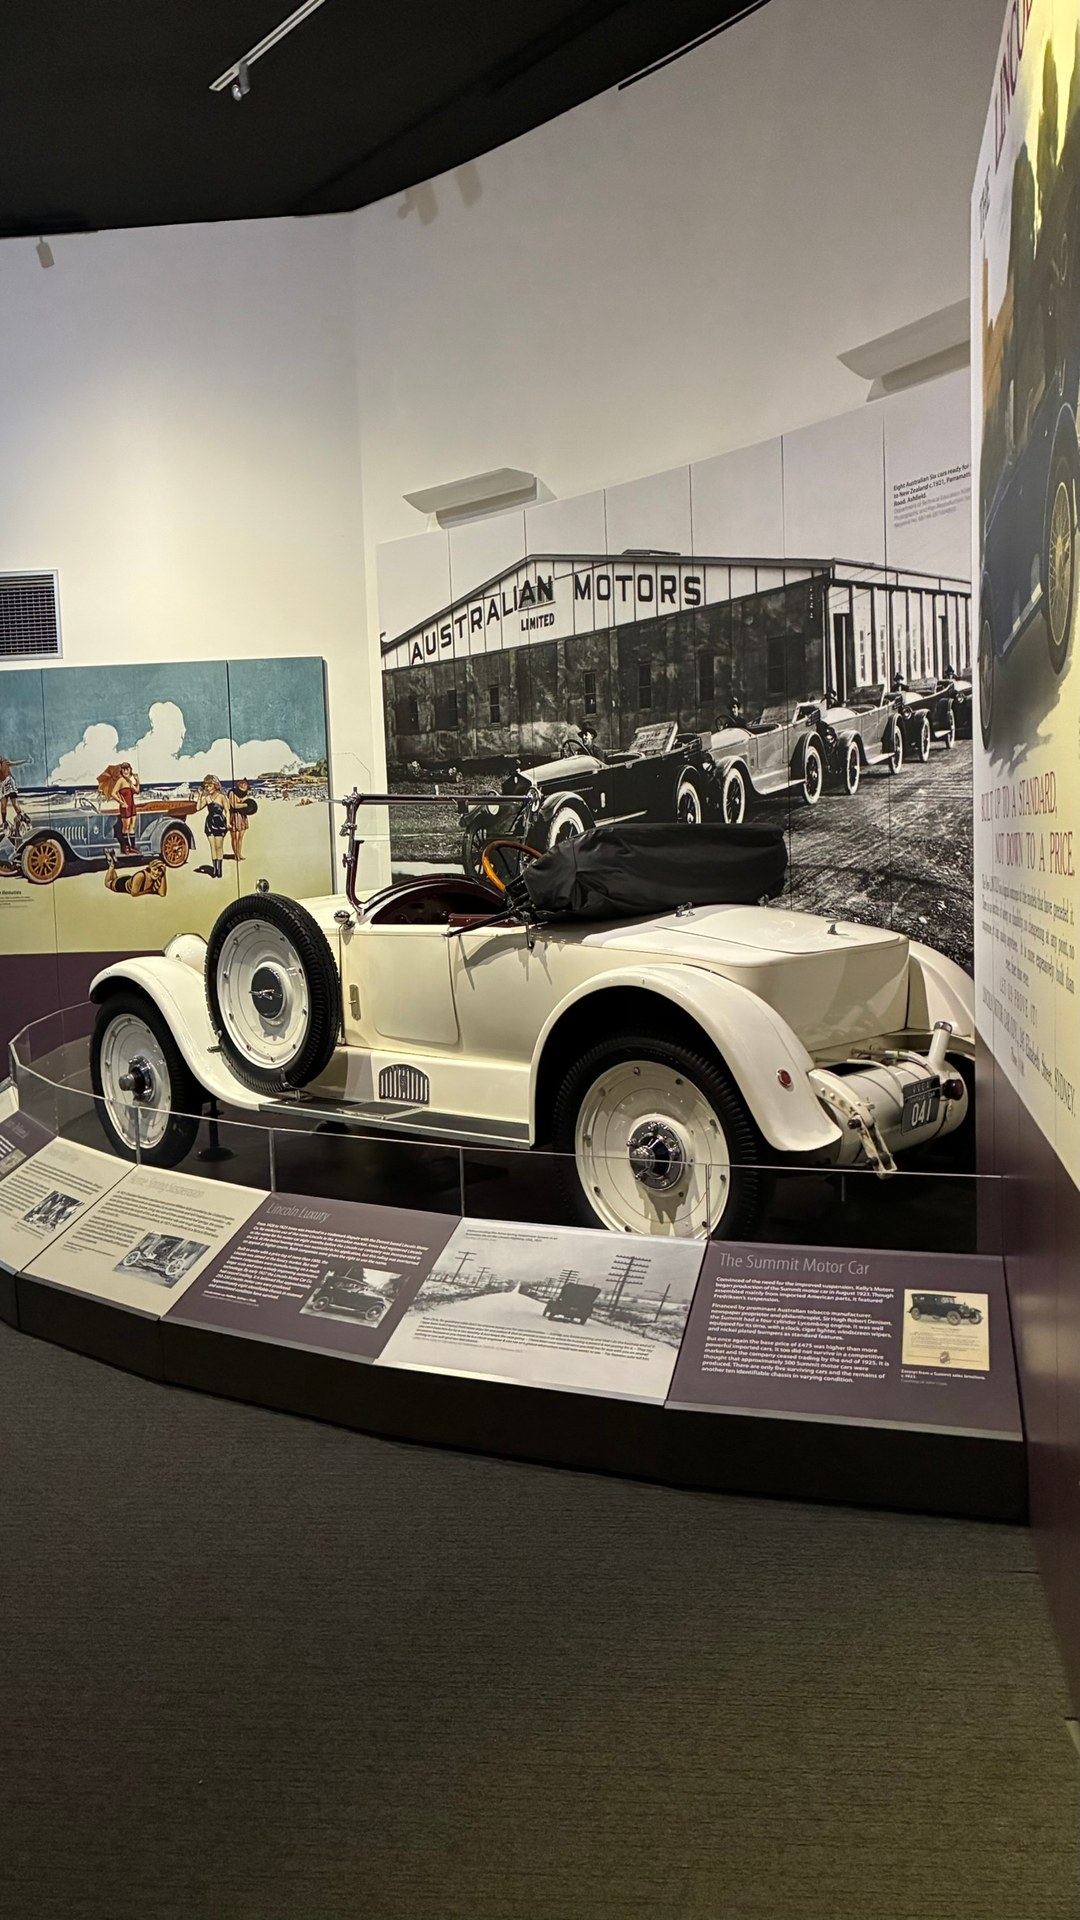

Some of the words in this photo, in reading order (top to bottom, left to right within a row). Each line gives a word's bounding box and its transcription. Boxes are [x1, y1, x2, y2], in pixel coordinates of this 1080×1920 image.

[906, 476, 929, 487] Australian
[948, 466, 961, 474] ready
[910, 484, 928, 494] Zealand
[575, 574, 701, 605] MOTORS
[412, 576, 552, 664] AUSTRALIAN
[521, 612, 555, 631] LIMITED
[994, 787, 1000, 818] UP
[1002, 785, 1009, 818] TO
[1011, 784, 1016, 818] A
[1018, 770, 1058, 818] STANDARD,
[1006, 831, 1023, 866] DOWN
[1026, 831, 1035, 869] TO
[1038, 832, 1045, 872] A
[1049, 831, 1075, 876] PRICE.
[912, 1098, 932, 1126] 041
[266, 1202, 300, 1219] Lincoln
[301, 1206, 331, 1224] Luxury
[720, 1252, 744, 1268] The
[746, 1254, 800, 1271] Summit
[803, 1258, 846, 1274] Motor
[848, 1260, 871, 1275] Car
[741, 1357, 783, 1366] approximately
